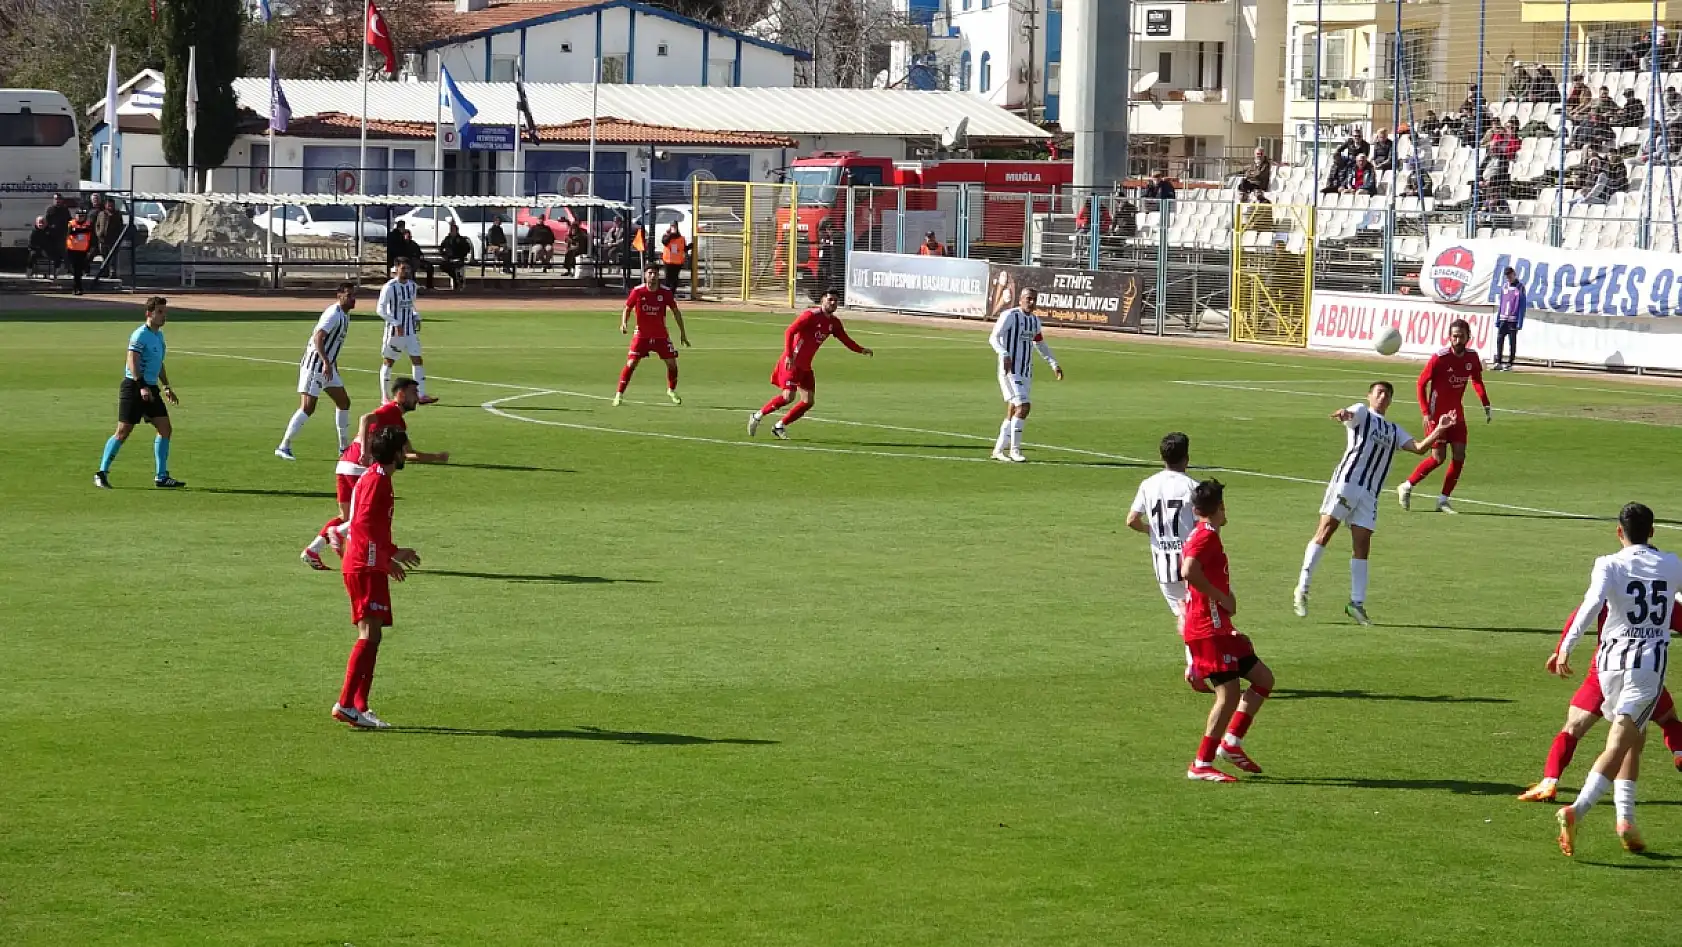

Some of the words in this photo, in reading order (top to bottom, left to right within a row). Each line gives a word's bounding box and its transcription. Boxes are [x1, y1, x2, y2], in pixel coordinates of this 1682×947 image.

[1005, 172, 1041, 182] MUĞLA
[1053, 271, 1095, 290] FETHİYE
[1487, 253, 1646, 317] APACHES
[1074, 292, 1119, 312] DÜNYASI
[1404, 308, 1491, 350] KOYUCU
[1151, 499, 1184, 538] 17
[1626, 580, 1669, 626] 35
